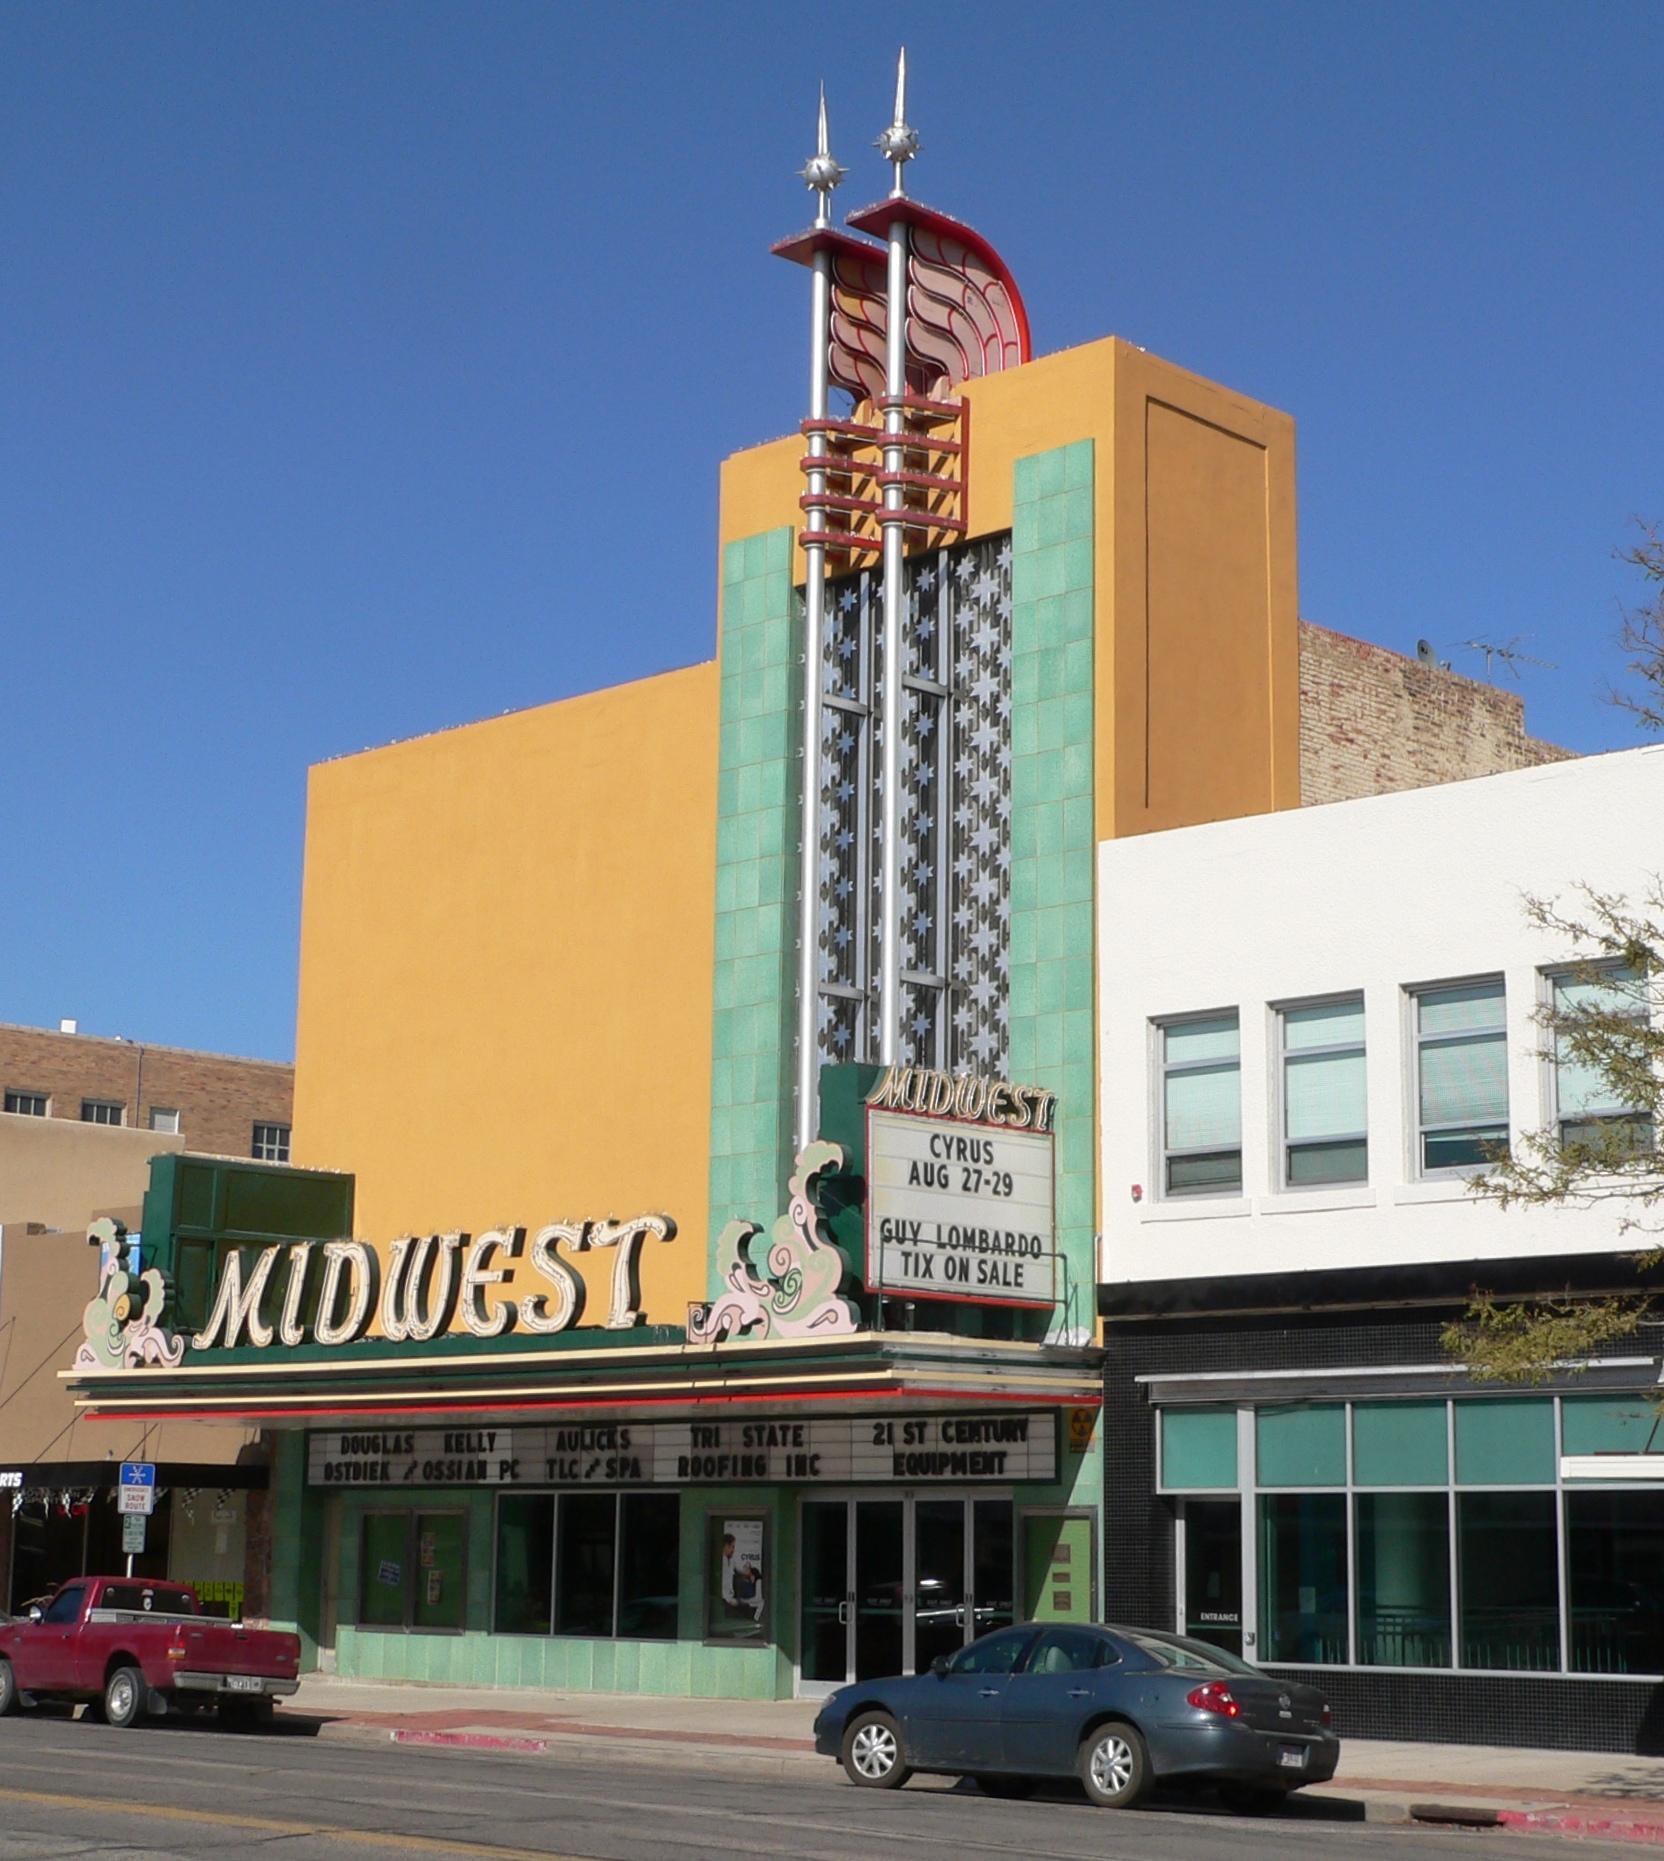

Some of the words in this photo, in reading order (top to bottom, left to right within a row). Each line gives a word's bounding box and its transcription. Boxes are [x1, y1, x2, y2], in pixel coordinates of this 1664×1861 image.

[866, 1063, 1057, 1131] MIDWEST
[929, 1133, 995, 1165] CYRUS
[908, 1160, 950, 1190] AUG
[961, 1167, 1014, 1198] 27-29
[880, 1218, 922, 1247] GUY
[936, 1224, 1043, 1260] LOMBARDO
[192, 1213, 677, 1350] MIDWEST
[901, 1252, 935, 1280] TIX
[944, 1256, 970, 1283] ON
[977, 1259, 1024, 1289] SALE
[340, 1434, 414, 1455] DOUGLAS
[444, 1431, 496, 1454] KELLY
[556, 1429, 631, 1452] AULICKS
[690, 1424, 720, 1449] TRI
[742, 1424, 804, 1448] STATE
[941, 1417, 1029, 1443] CENTURY
[323, 1461, 391, 1482] OSTDIEK
[422, 1460, 488, 1482] OSSIAN
[499, 1459, 520, 1481] PC
[546, 1458, 579, 1480] TLC
[605, 1456, 641, 1479] SPA
[678, 1453, 767, 1479] ROOFING
[785, 1453, 822, 1477] INC
[892, 1450, 1007, 1477] EQUIPMENT
[125, 1502, 146, 1511] ROUTE
[1200, 1612, 1239, 1622] ENTRANCE
